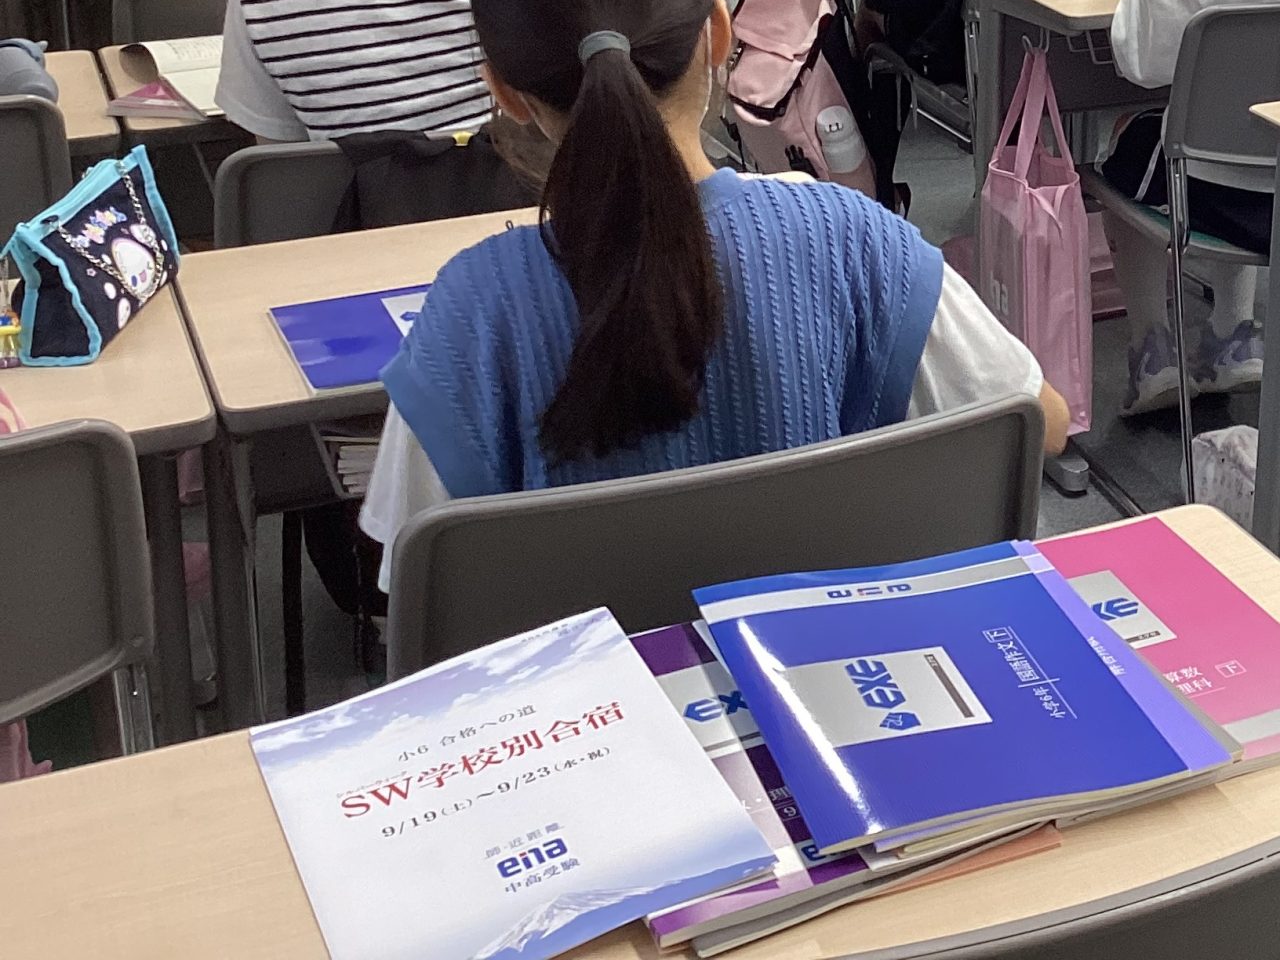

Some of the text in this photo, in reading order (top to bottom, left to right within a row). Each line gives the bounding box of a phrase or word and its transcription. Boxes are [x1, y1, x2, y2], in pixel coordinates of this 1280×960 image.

[682, 690, 749, 723] EX
[844, 659, 907, 709] EXE
[398, 704, 537, 762] 小6 合格への道
[340, 701, 625, 819] SW学校別合宿
[497, 837, 568, 878] ena
